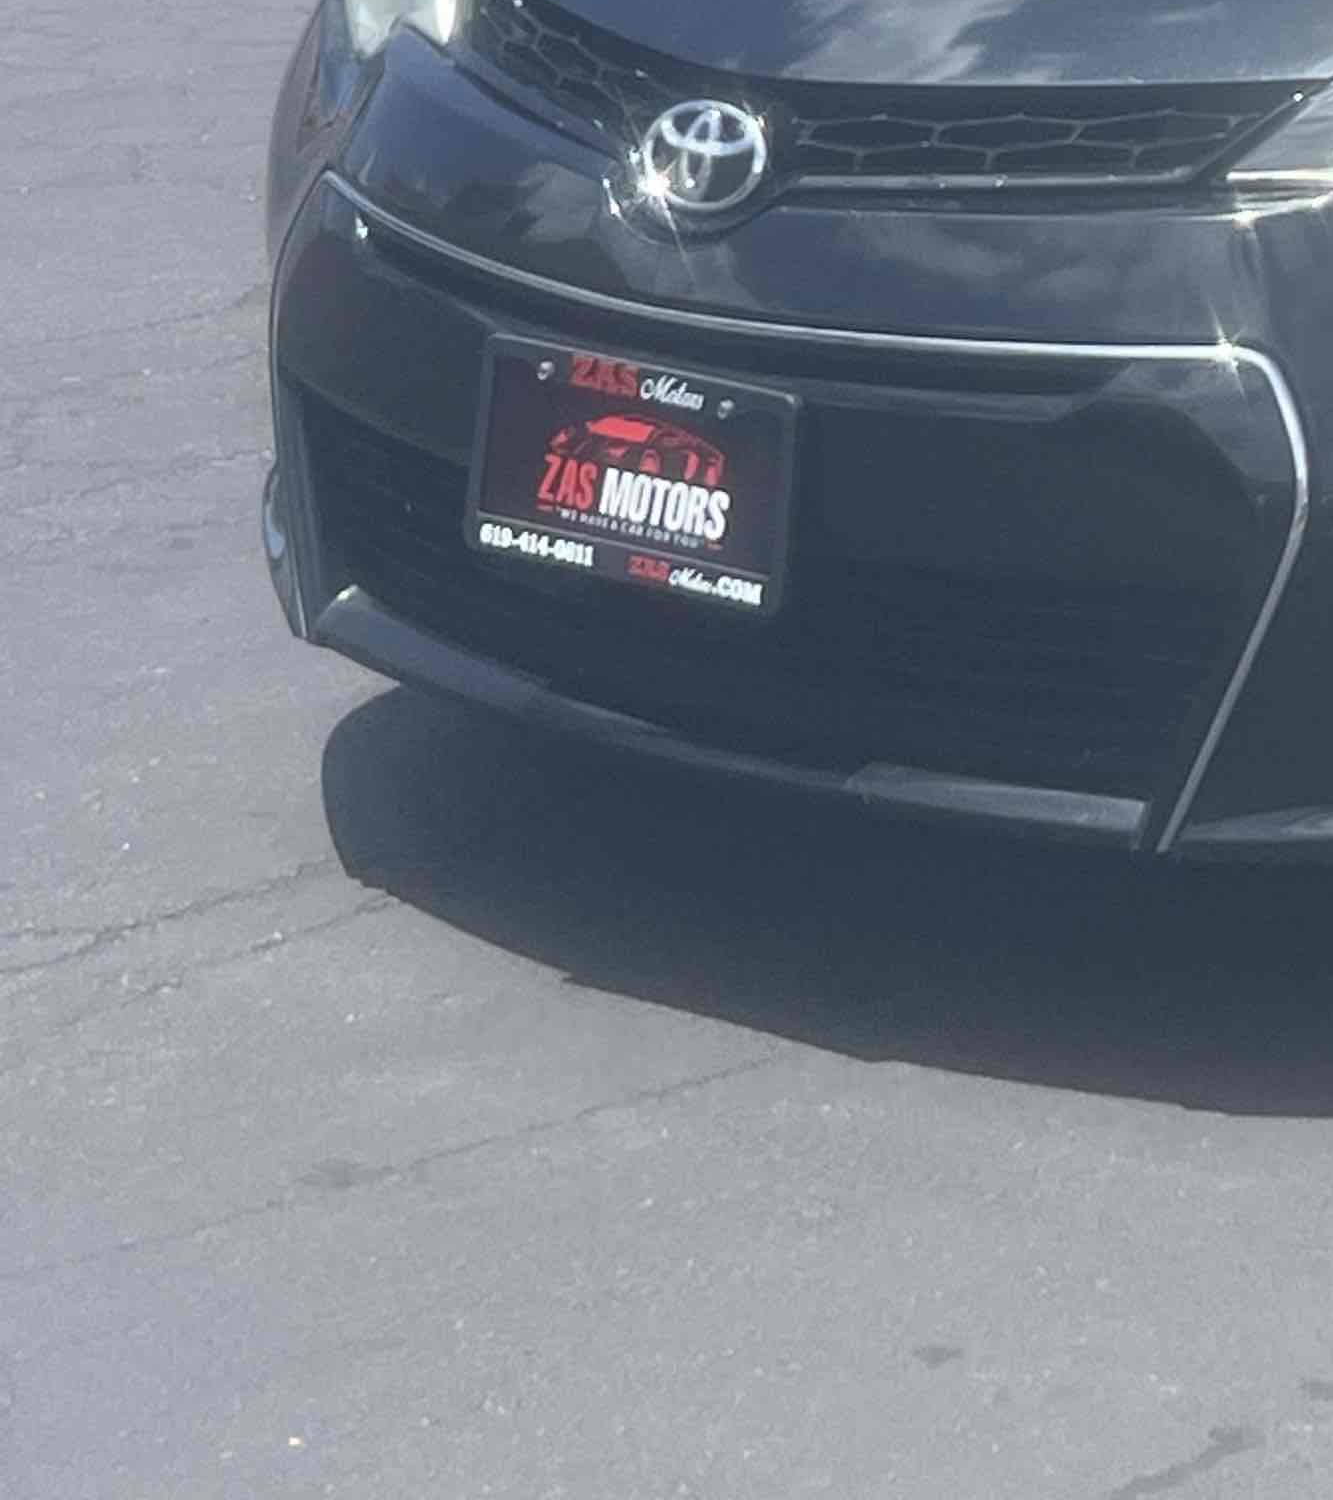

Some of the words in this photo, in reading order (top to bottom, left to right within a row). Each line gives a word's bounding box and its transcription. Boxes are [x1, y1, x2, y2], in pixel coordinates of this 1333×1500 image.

[571, 354, 640, 397] ZAS
[640, 374, 704, 410] Motors
[536, 453, 598, 511] ZAS
[599, 467, 730, 541] MOTORS
